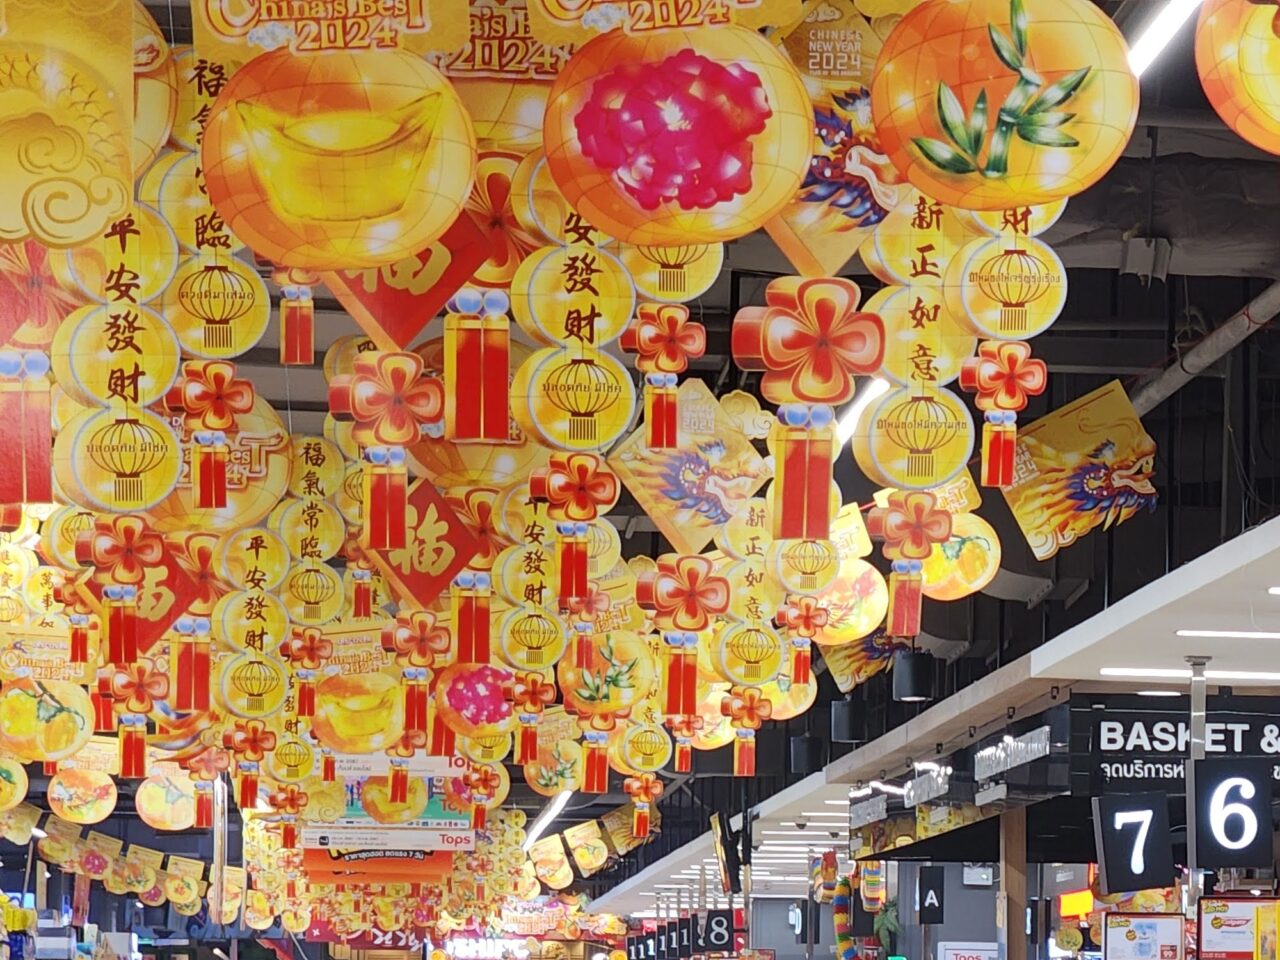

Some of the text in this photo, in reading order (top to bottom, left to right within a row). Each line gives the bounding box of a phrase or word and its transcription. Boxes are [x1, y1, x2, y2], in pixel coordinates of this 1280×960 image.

[298, 19, 397, 50] 2024
[808, 41, 861, 52] NEW YEAR
[809, 29, 862, 40] CHINESE
[446, 39, 559, 74] 2024
[808, 52, 861, 70] 2024
[103, 213, 147, 403] 平安發財
[389, 502, 457, 577] 福
[244, 535, 269, 650] 平安發財
[1208, 776, 1259, 850] 6
[439, 833, 471, 847] Tops
[1113, 808, 1154, 875] 7
[924, 889, 940, 908] A
[709, 916, 729, 945] 8
